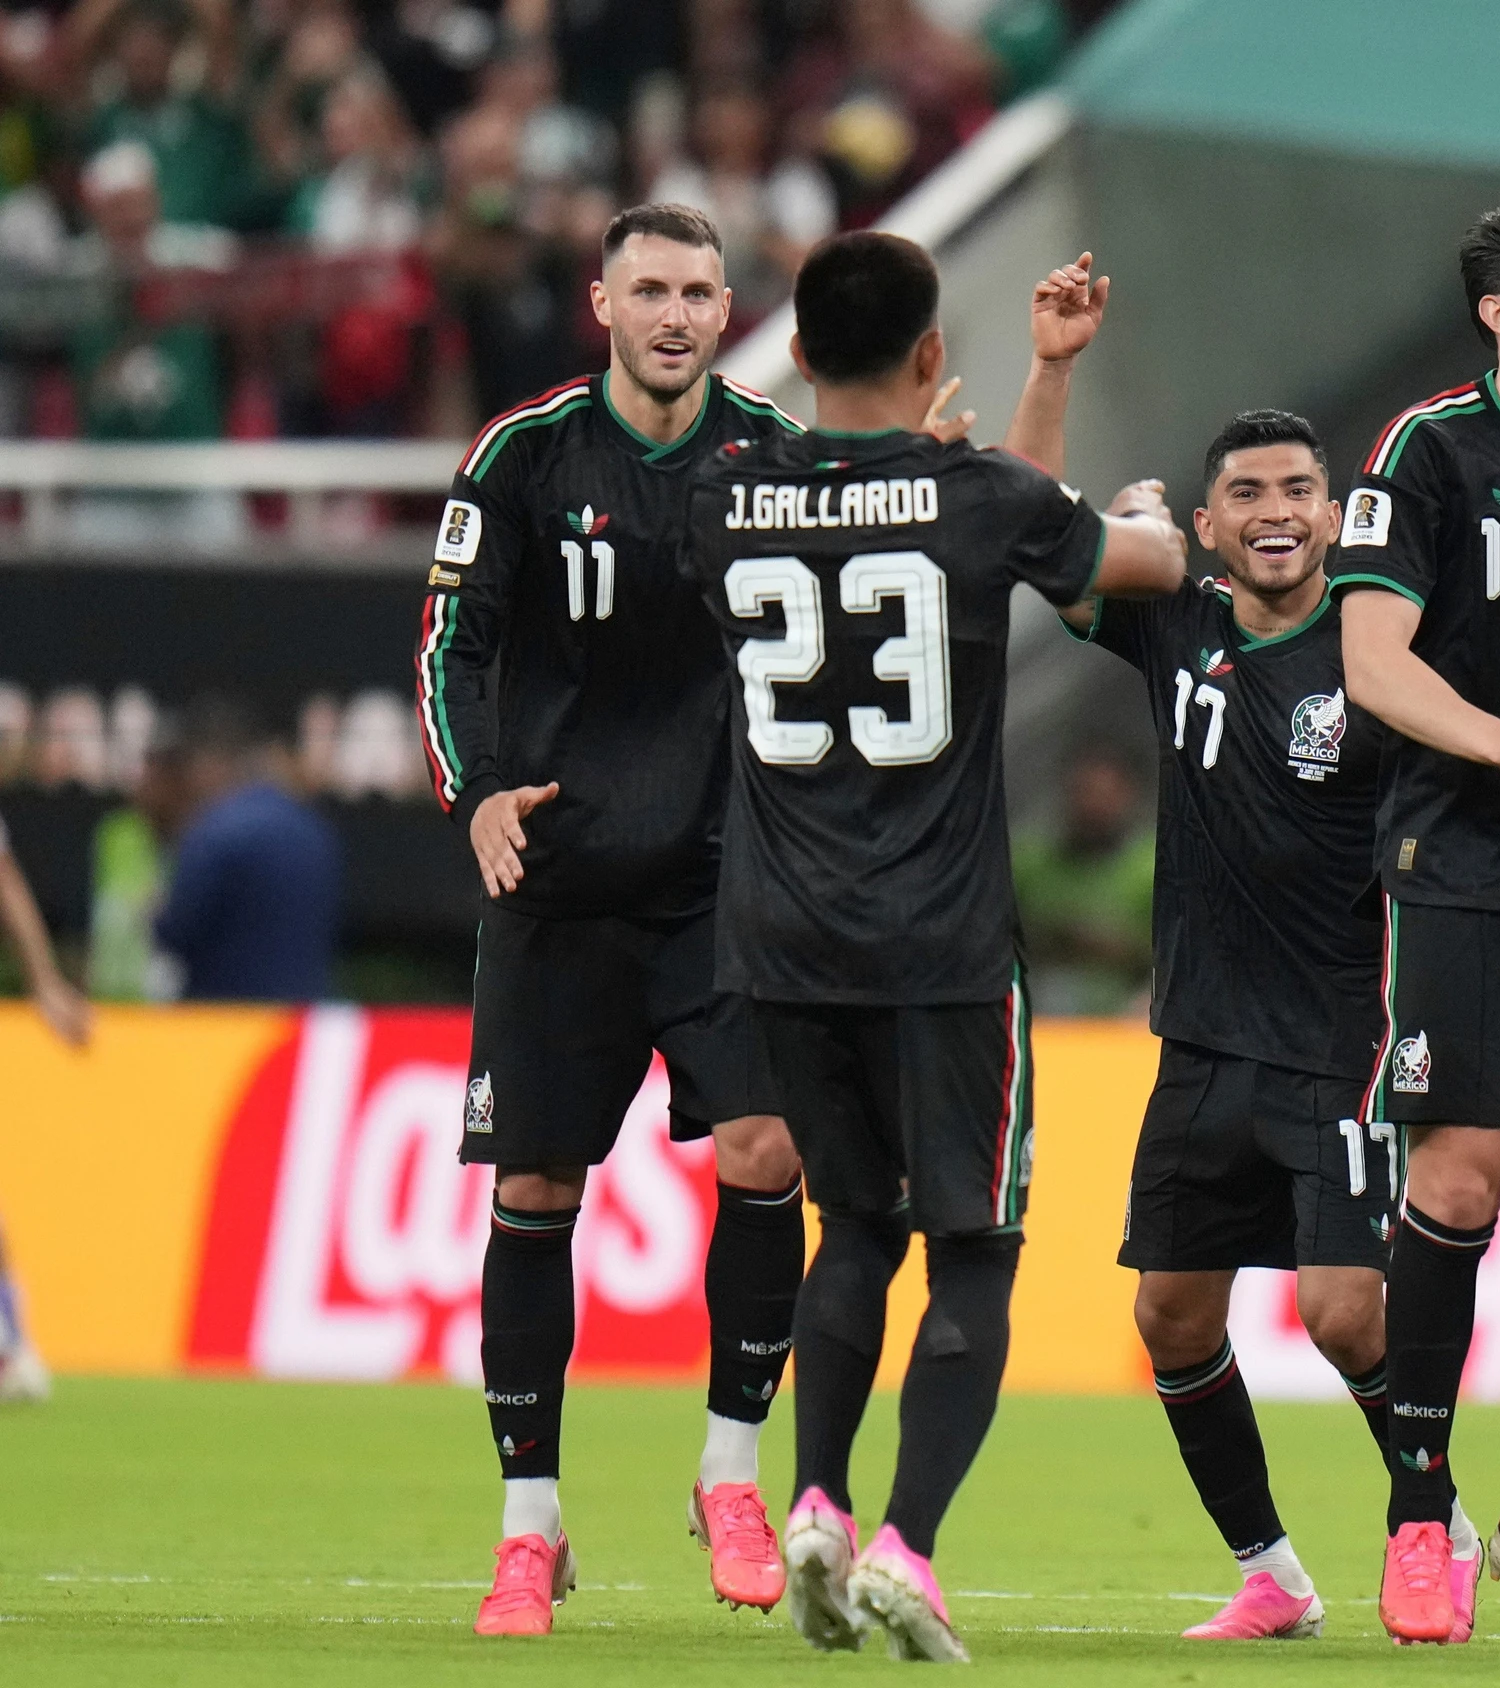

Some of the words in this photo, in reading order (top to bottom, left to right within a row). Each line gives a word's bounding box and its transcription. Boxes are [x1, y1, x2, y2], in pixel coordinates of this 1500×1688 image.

[726, 478, 938, 529] J.GALLARDO
[560, 540, 615, 621] 11
[724, 551, 954, 766] 23
[1173, 668, 1227, 770] 17
[1292, 744, 1337, 759] MÉXICO
[1395, 1080, 1426, 1090] MÉXICO
[467, 1120, 490, 1131] MÉXICO
[1339, 1119, 1398, 1201] 17
[741, 1337, 793, 1356] MÉXIC
[1393, 1401, 1449, 1419] MÉXICO
